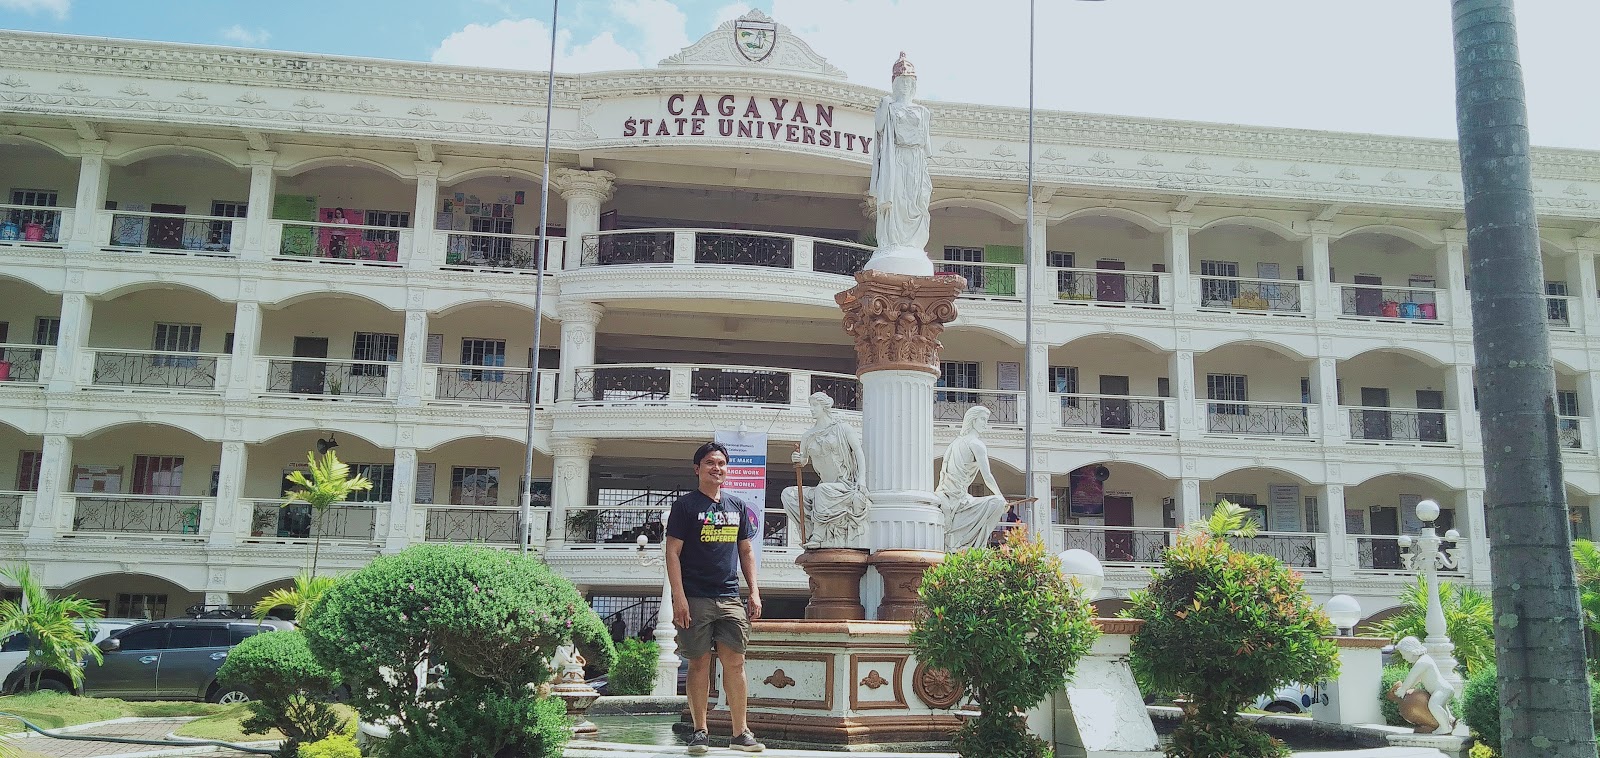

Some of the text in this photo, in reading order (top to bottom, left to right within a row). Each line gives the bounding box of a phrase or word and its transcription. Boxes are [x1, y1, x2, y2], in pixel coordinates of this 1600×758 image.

[667, 94, 834, 127] CAGAYAN
[623, 117, 872, 154] STATE UNIVERSITY
